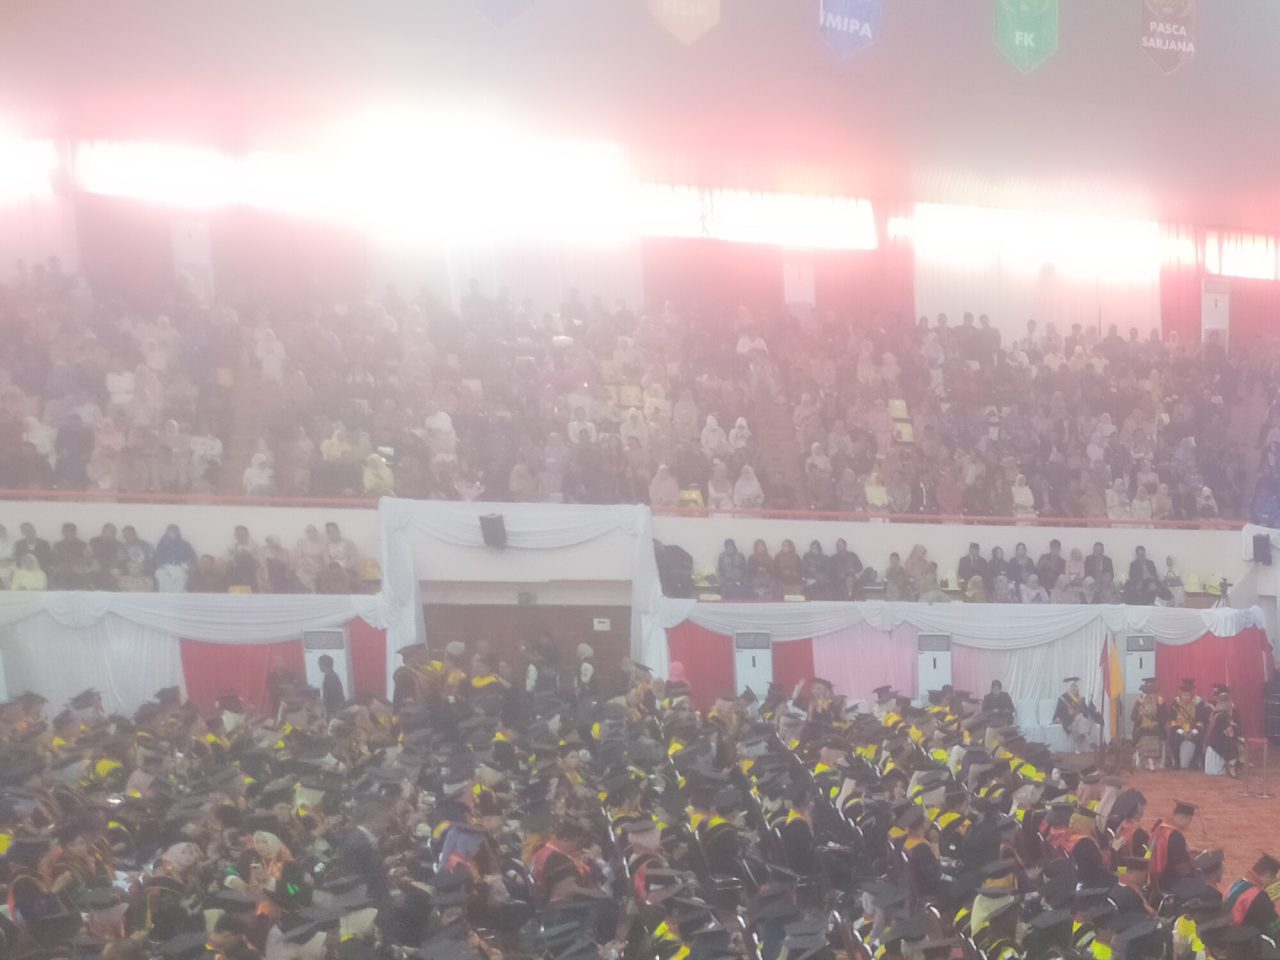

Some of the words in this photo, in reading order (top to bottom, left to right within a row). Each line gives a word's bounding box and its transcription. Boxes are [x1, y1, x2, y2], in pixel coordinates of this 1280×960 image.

[1149, 21, 1187, 36] PASCA
[1014, 30, 1036, 47] FK
[1142, 36, 1195, 52] SARJANA
